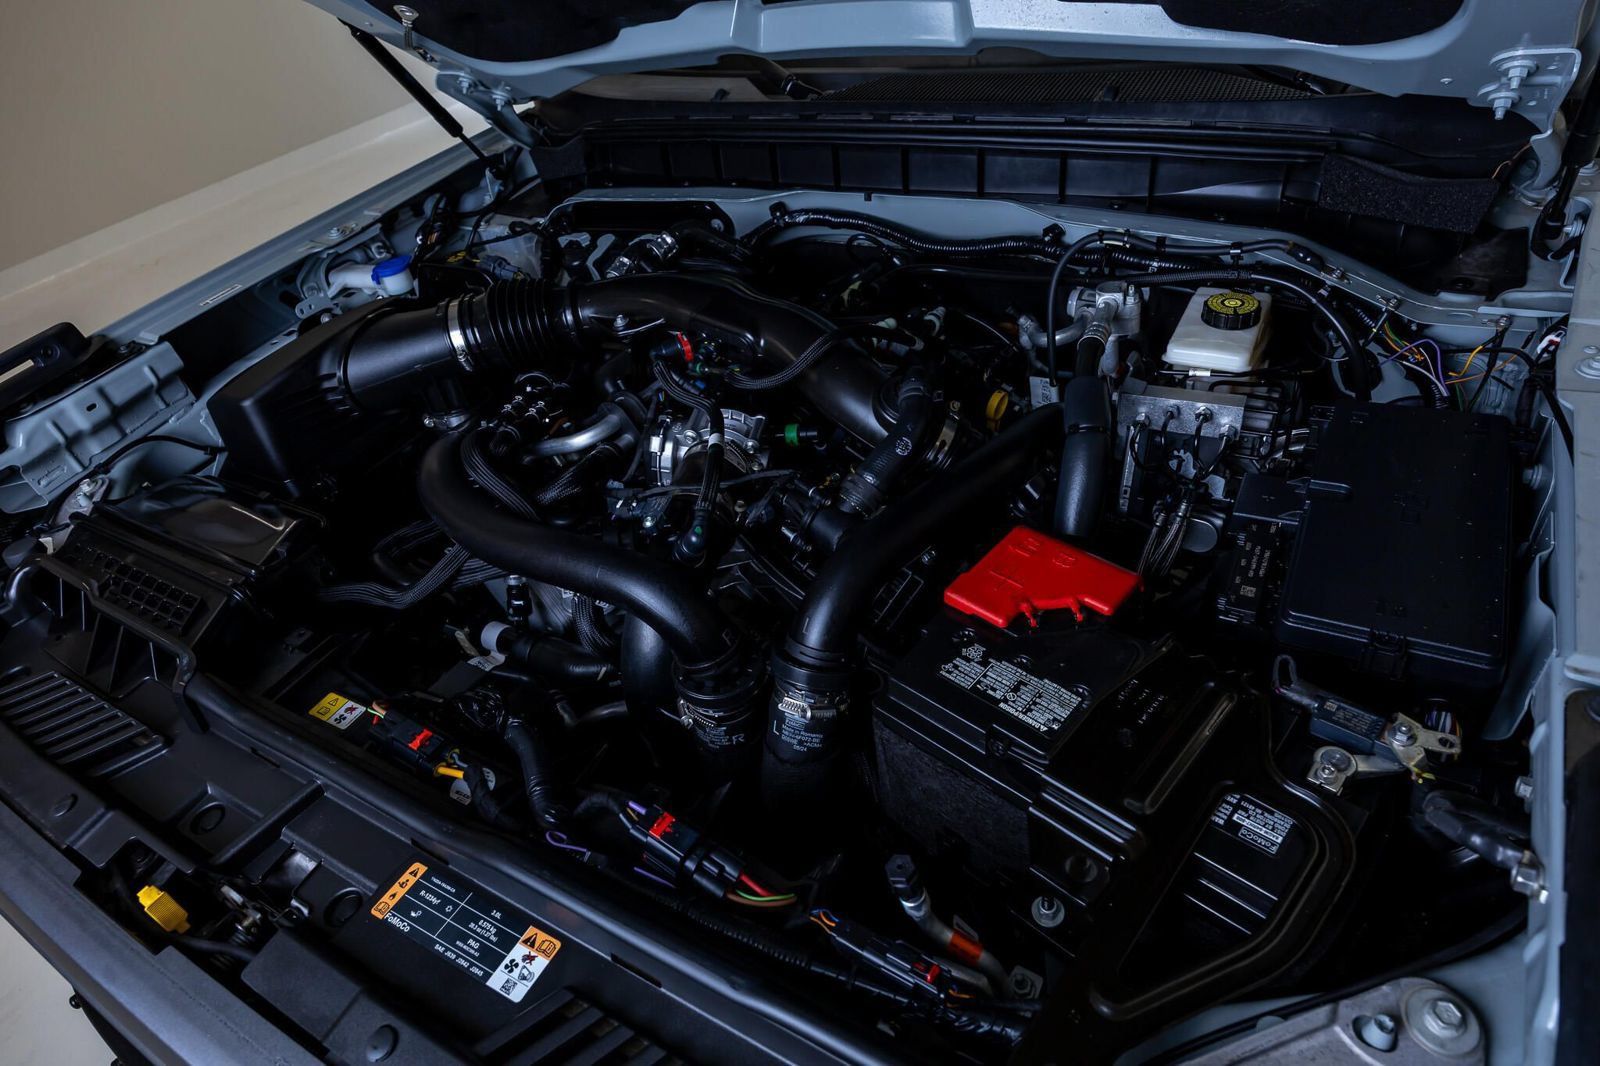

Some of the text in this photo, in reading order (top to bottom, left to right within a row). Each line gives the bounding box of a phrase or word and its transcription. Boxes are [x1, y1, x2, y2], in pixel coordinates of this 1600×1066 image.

[773, 720, 780, 735] L
[732, 733, 745, 745] R
[1242, 829, 1277, 851] FoMoCo
[419, 890, 441, 905] R-1234yf
[384, 912, 410, 932] FoMoCo
[434, 943, 446, 953] SAE
[466, 938, 480, 949] PAG
